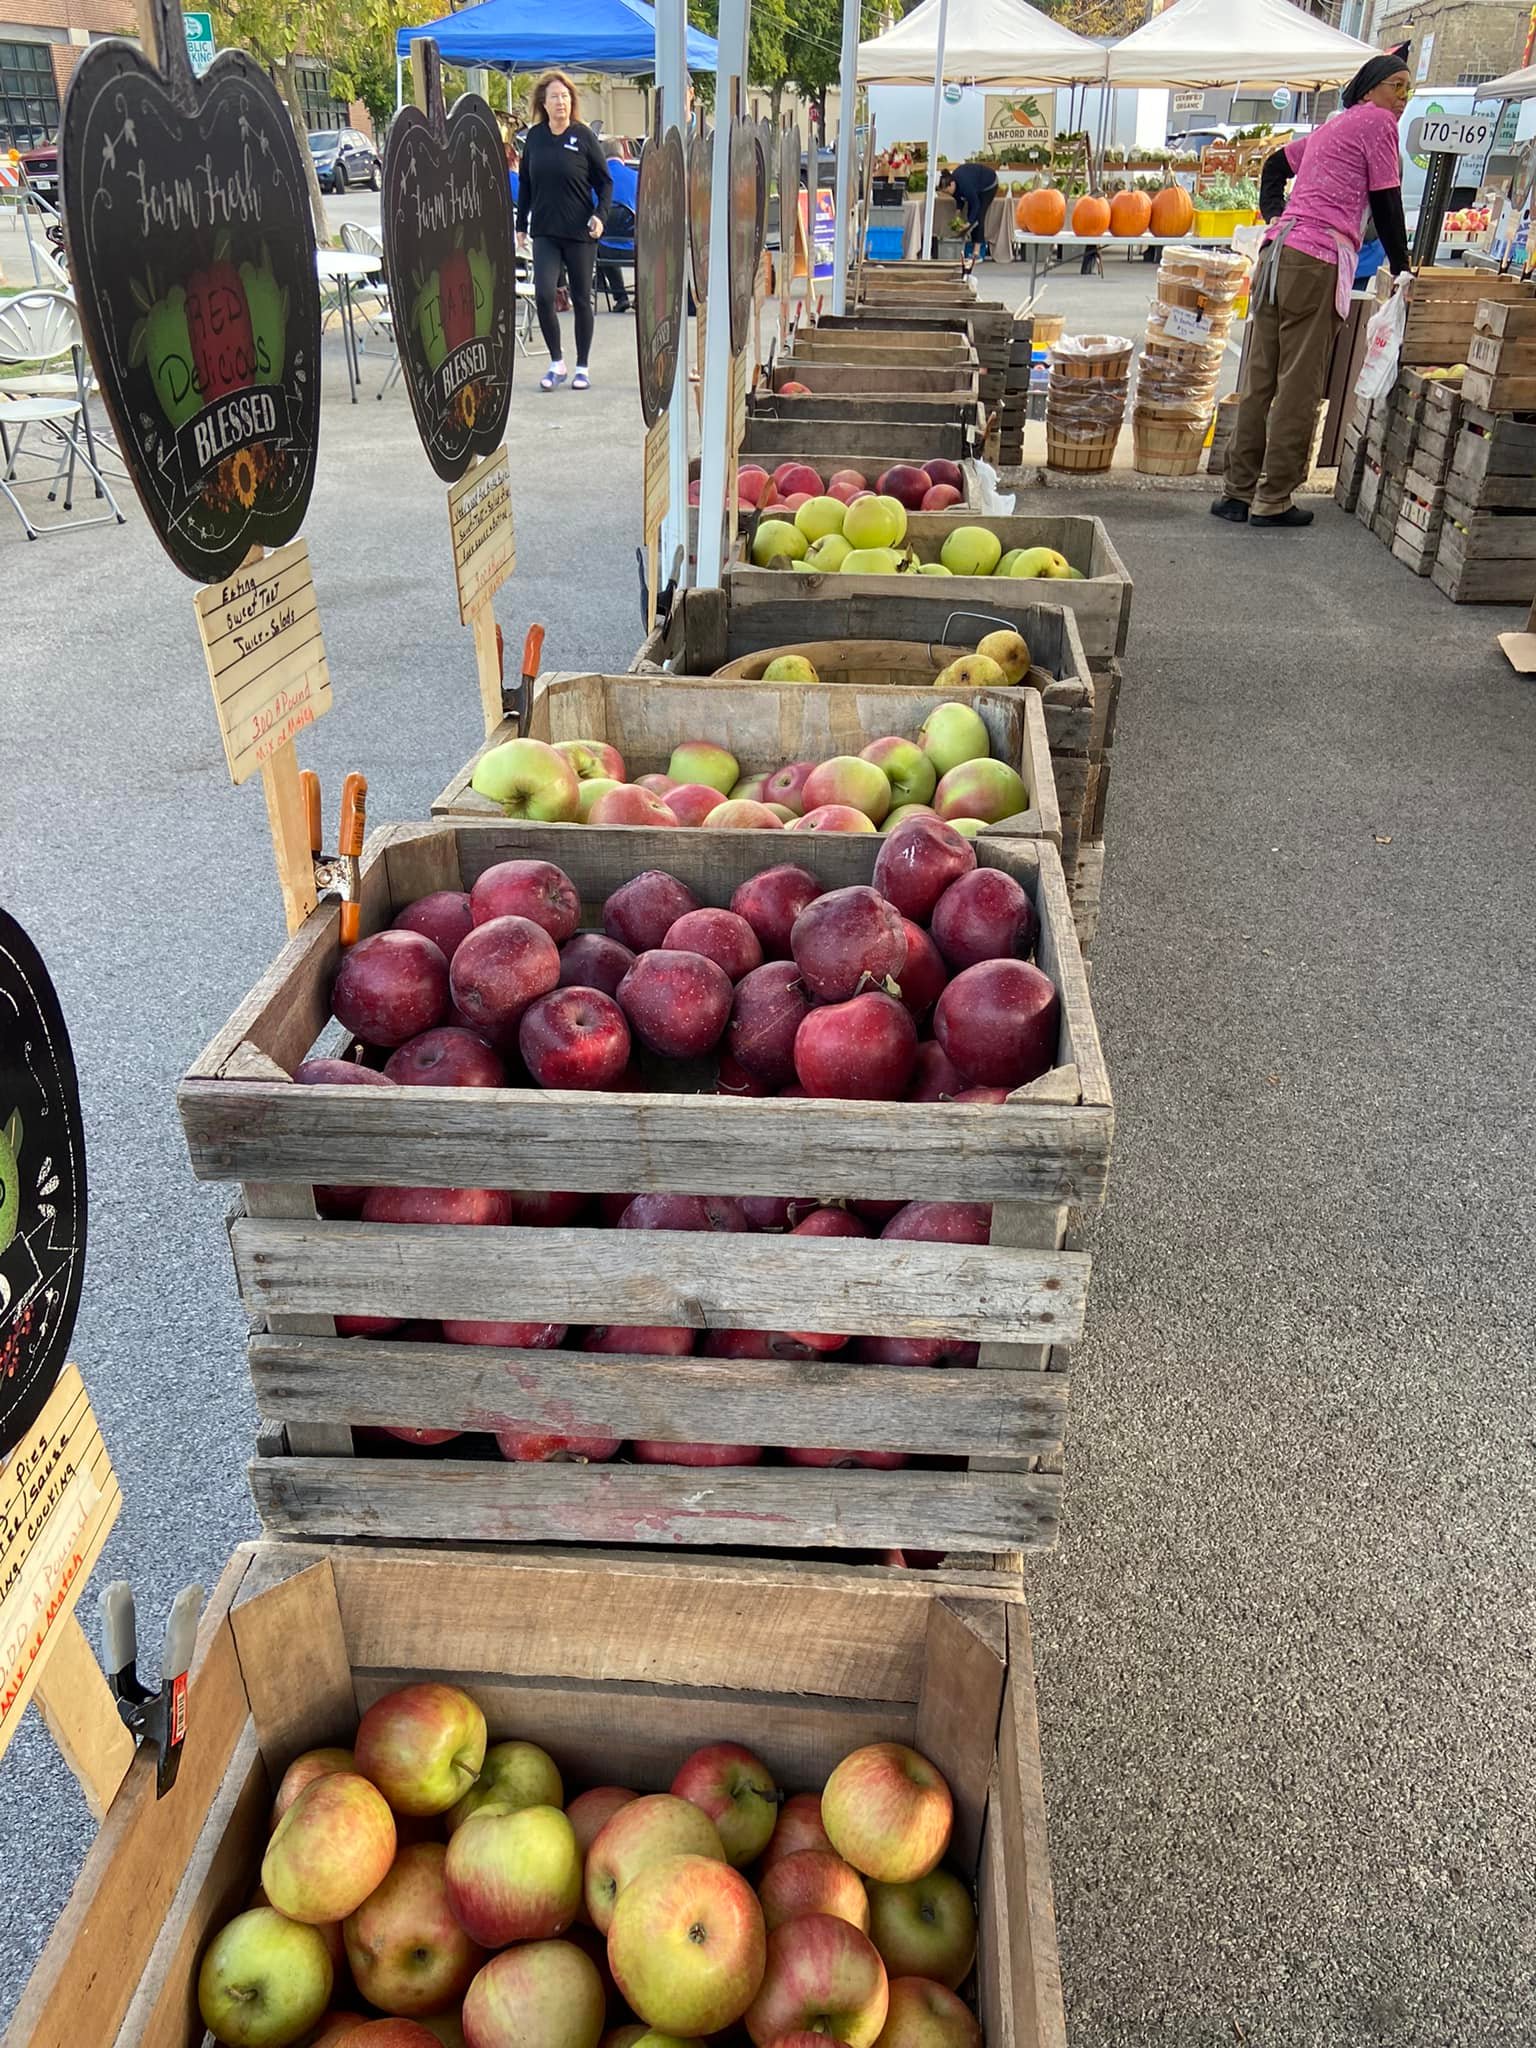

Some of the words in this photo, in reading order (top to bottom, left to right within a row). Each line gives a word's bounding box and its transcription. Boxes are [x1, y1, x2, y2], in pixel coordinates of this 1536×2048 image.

[187, 42, 208, 52] BLIC
[192, 53, 212, 63] KING
[988, 129, 1025, 140] BANFORD
[1027, 129, 1049, 138] ROAD
[1423, 123, 1487, 145] 170-169
[126, 158, 200, 237] Farm
[195, 143, 262, 225] Fresh
[411, 184, 448, 239] Farm
[445, 160, 482, 225] Fresh
[442, 342, 488, 400] BLESSED
[193, 393, 277, 468] BLESSED
